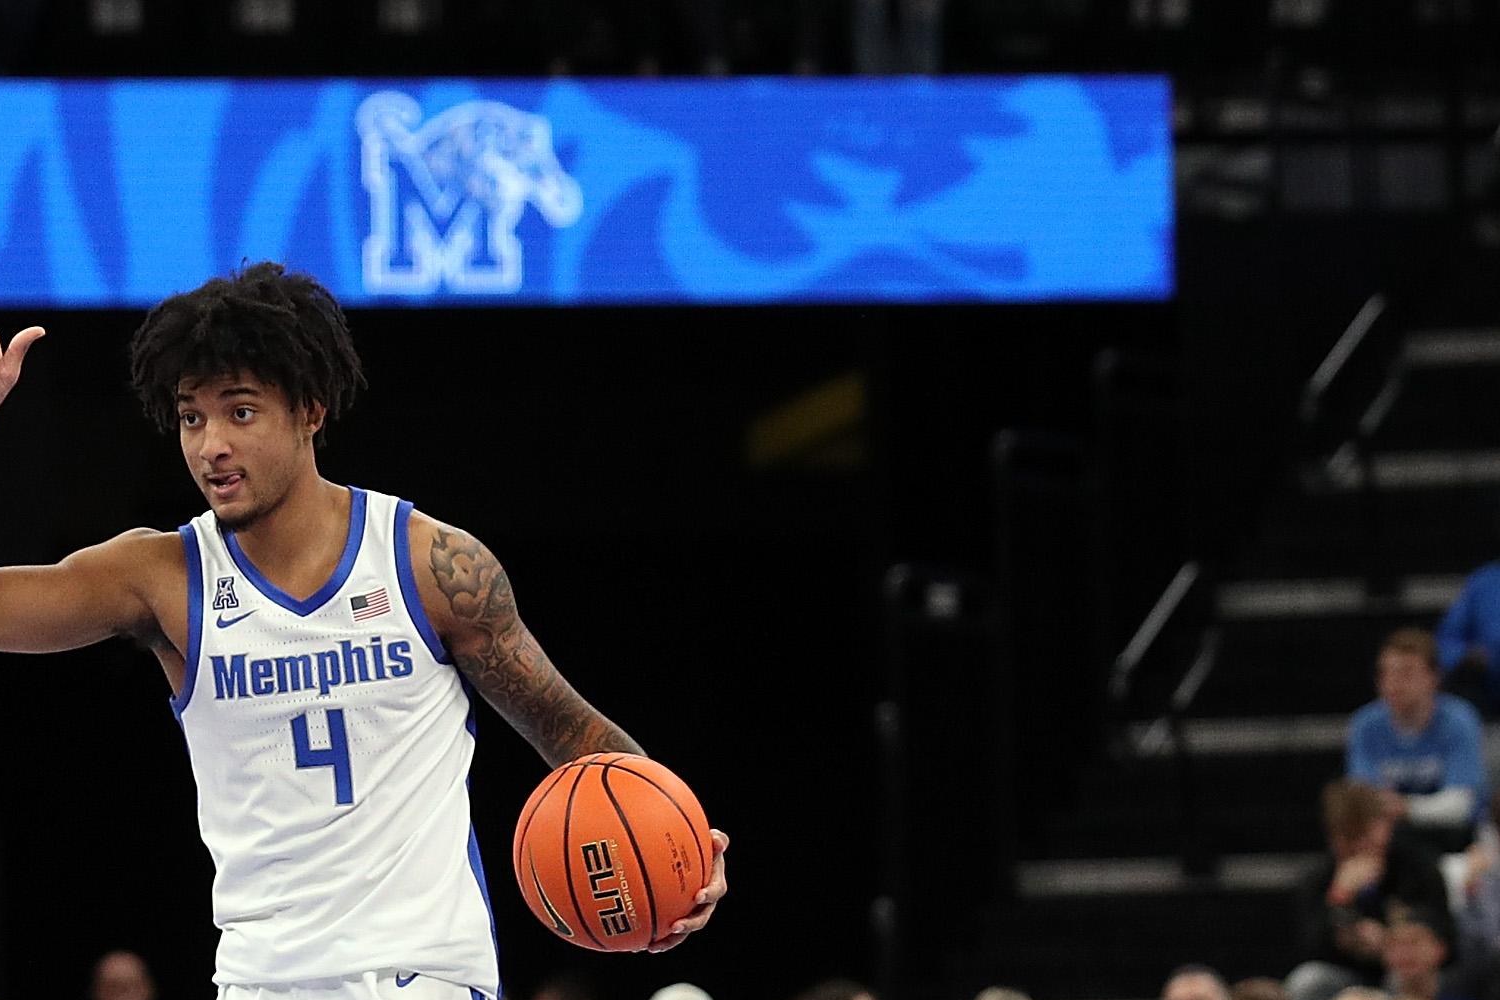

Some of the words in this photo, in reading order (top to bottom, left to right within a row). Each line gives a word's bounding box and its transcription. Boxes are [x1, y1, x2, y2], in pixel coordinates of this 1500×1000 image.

[360, 132, 524, 296] M
[208, 635, 415, 700] Memphis
[290, 708, 355, 807] 4
[580, 839, 632, 937] ELITE
[610, 839, 641, 930] AMPIONP
